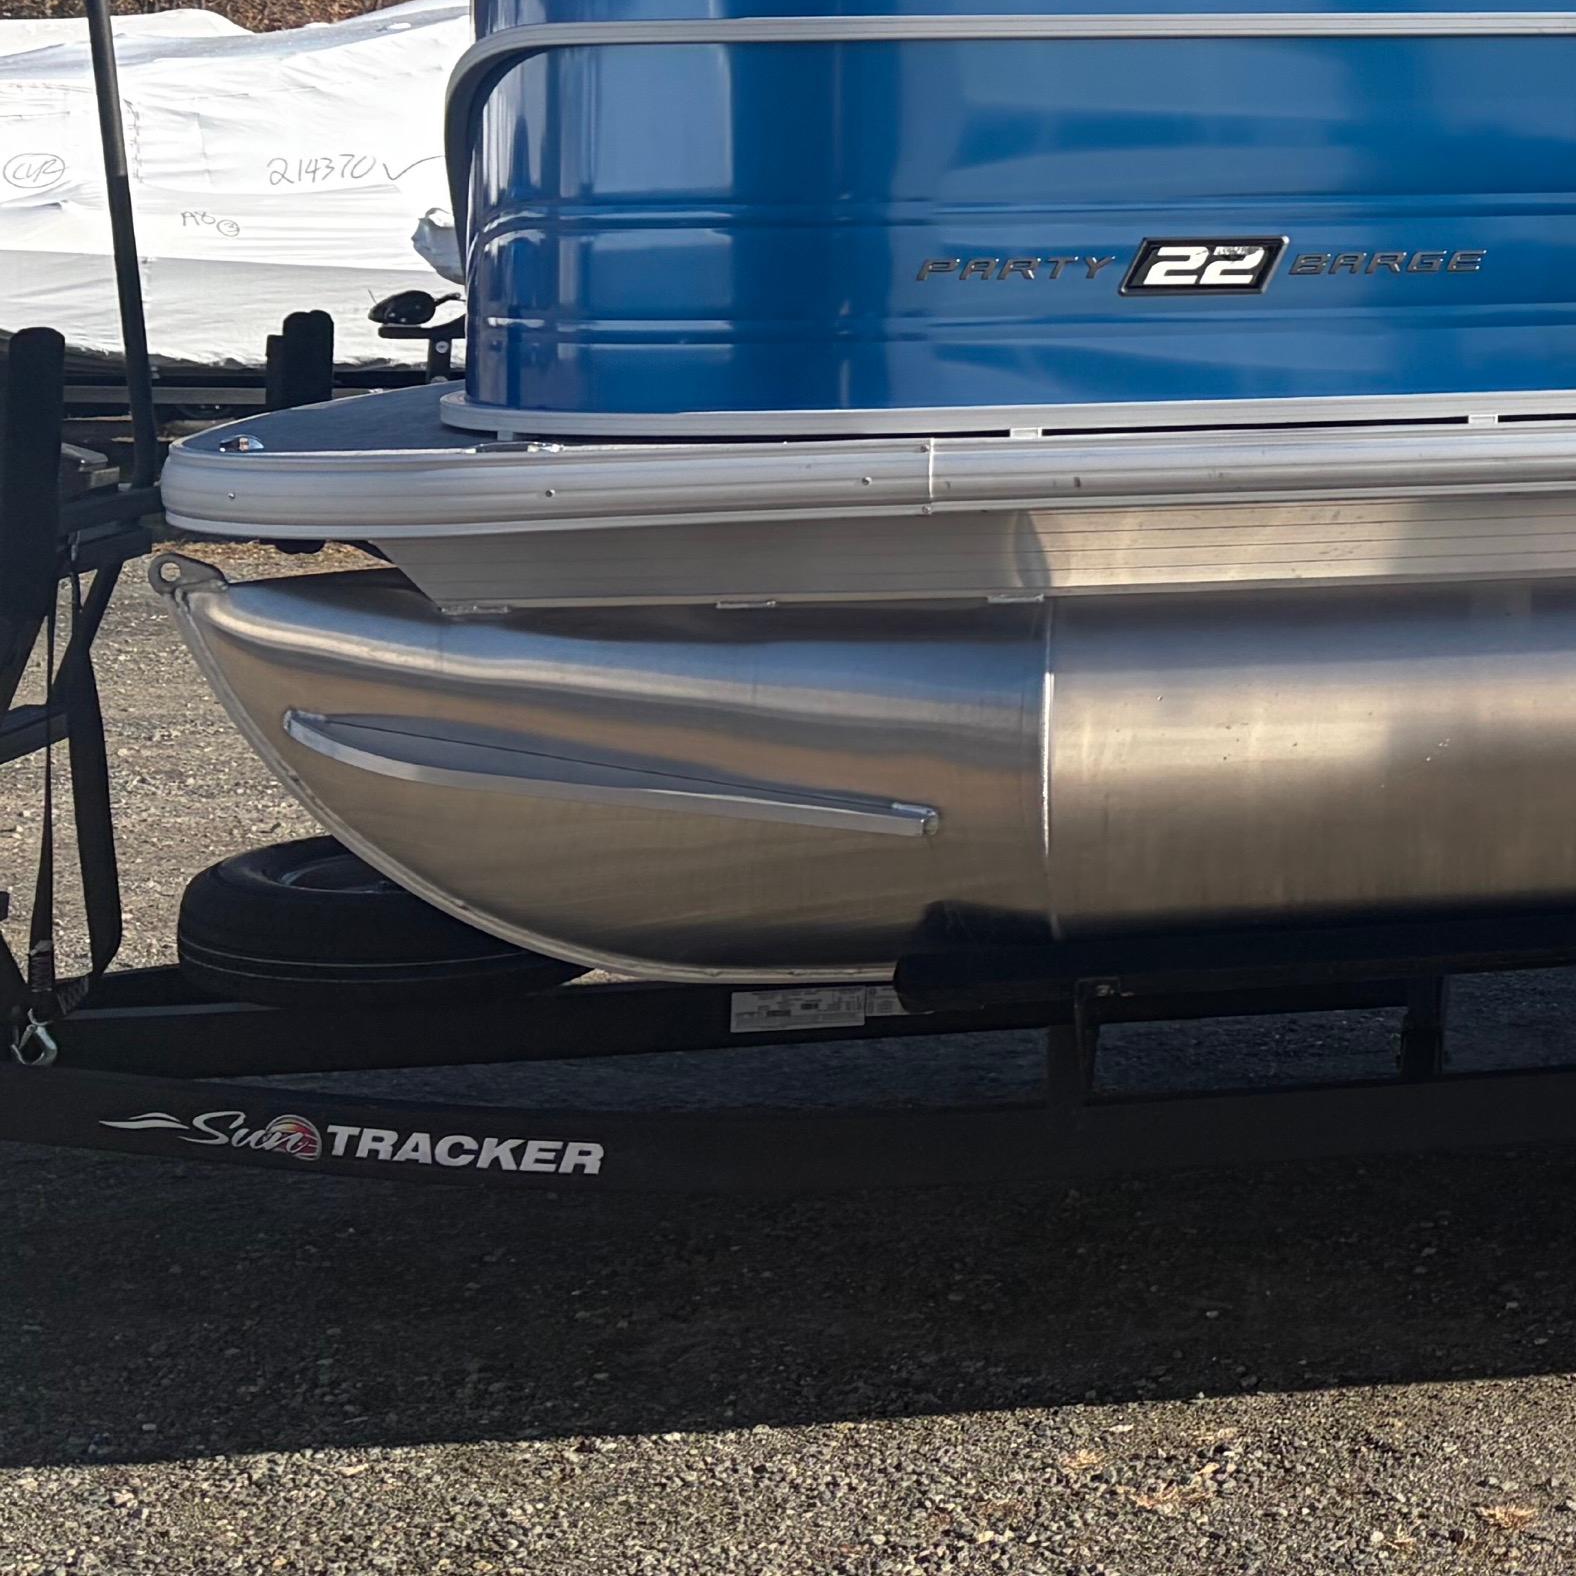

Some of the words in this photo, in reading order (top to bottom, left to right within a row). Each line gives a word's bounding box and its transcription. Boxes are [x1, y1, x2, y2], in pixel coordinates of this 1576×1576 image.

[266, 153, 377, 186] 214370
[916, 254, 1116, 282] PARTY
[1143, 245, 1264, 286] 22
[1289, 249, 1488, 276] BARGE
[178, 1110, 314, 1154] Sun
[326, 1124, 606, 1175] TRACKER
